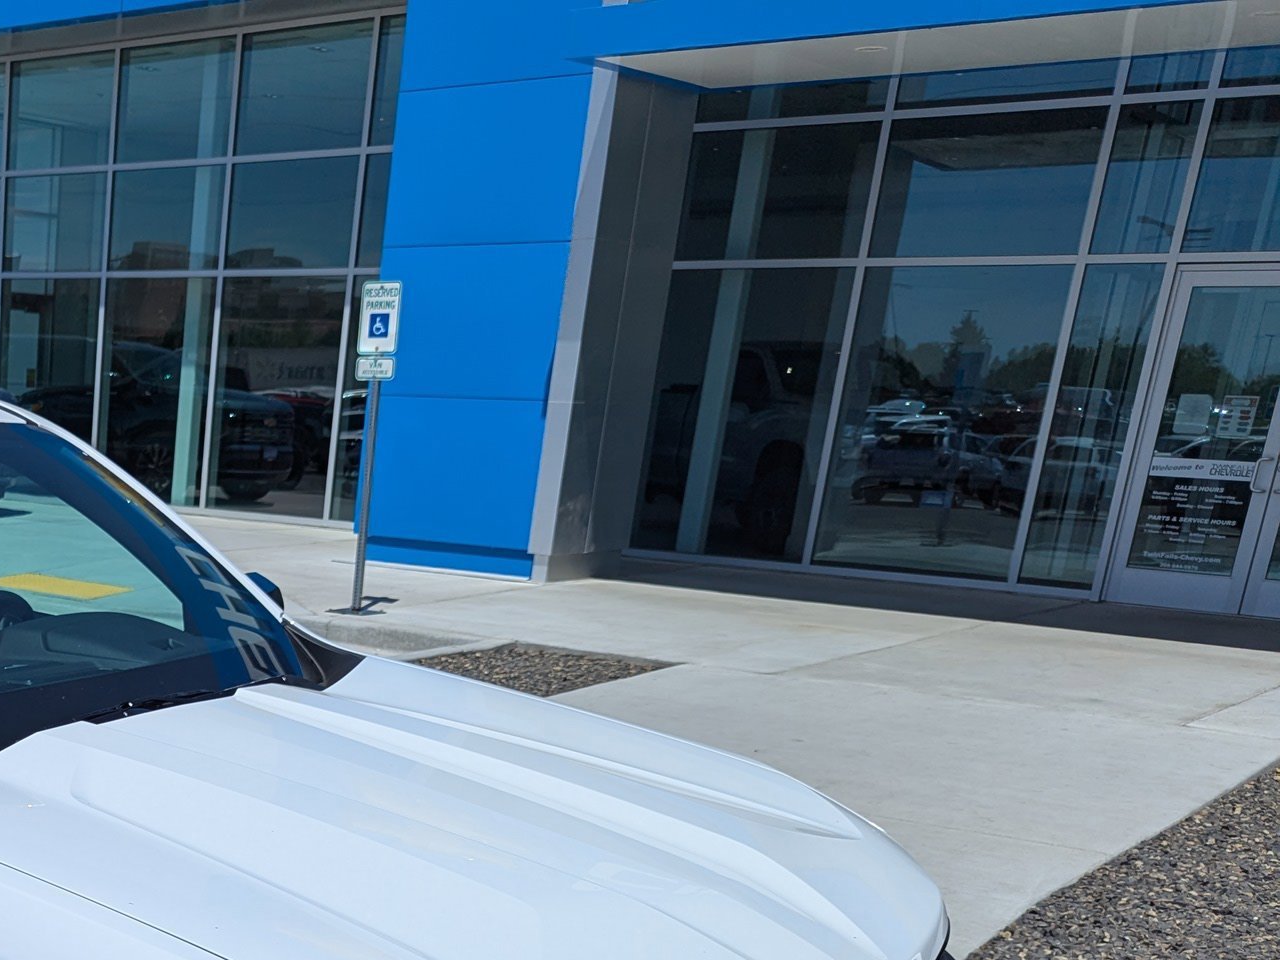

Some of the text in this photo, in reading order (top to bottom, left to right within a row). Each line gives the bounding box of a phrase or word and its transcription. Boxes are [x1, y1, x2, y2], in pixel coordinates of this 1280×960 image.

[364, 287, 399, 298] RESERVED
[366, 300, 396, 310] PARKING
[1151, 464, 1192, 472] Welcome
[1174, 484, 1198, 492] SALES
[1178, 516, 1210, 524] SERVICE
